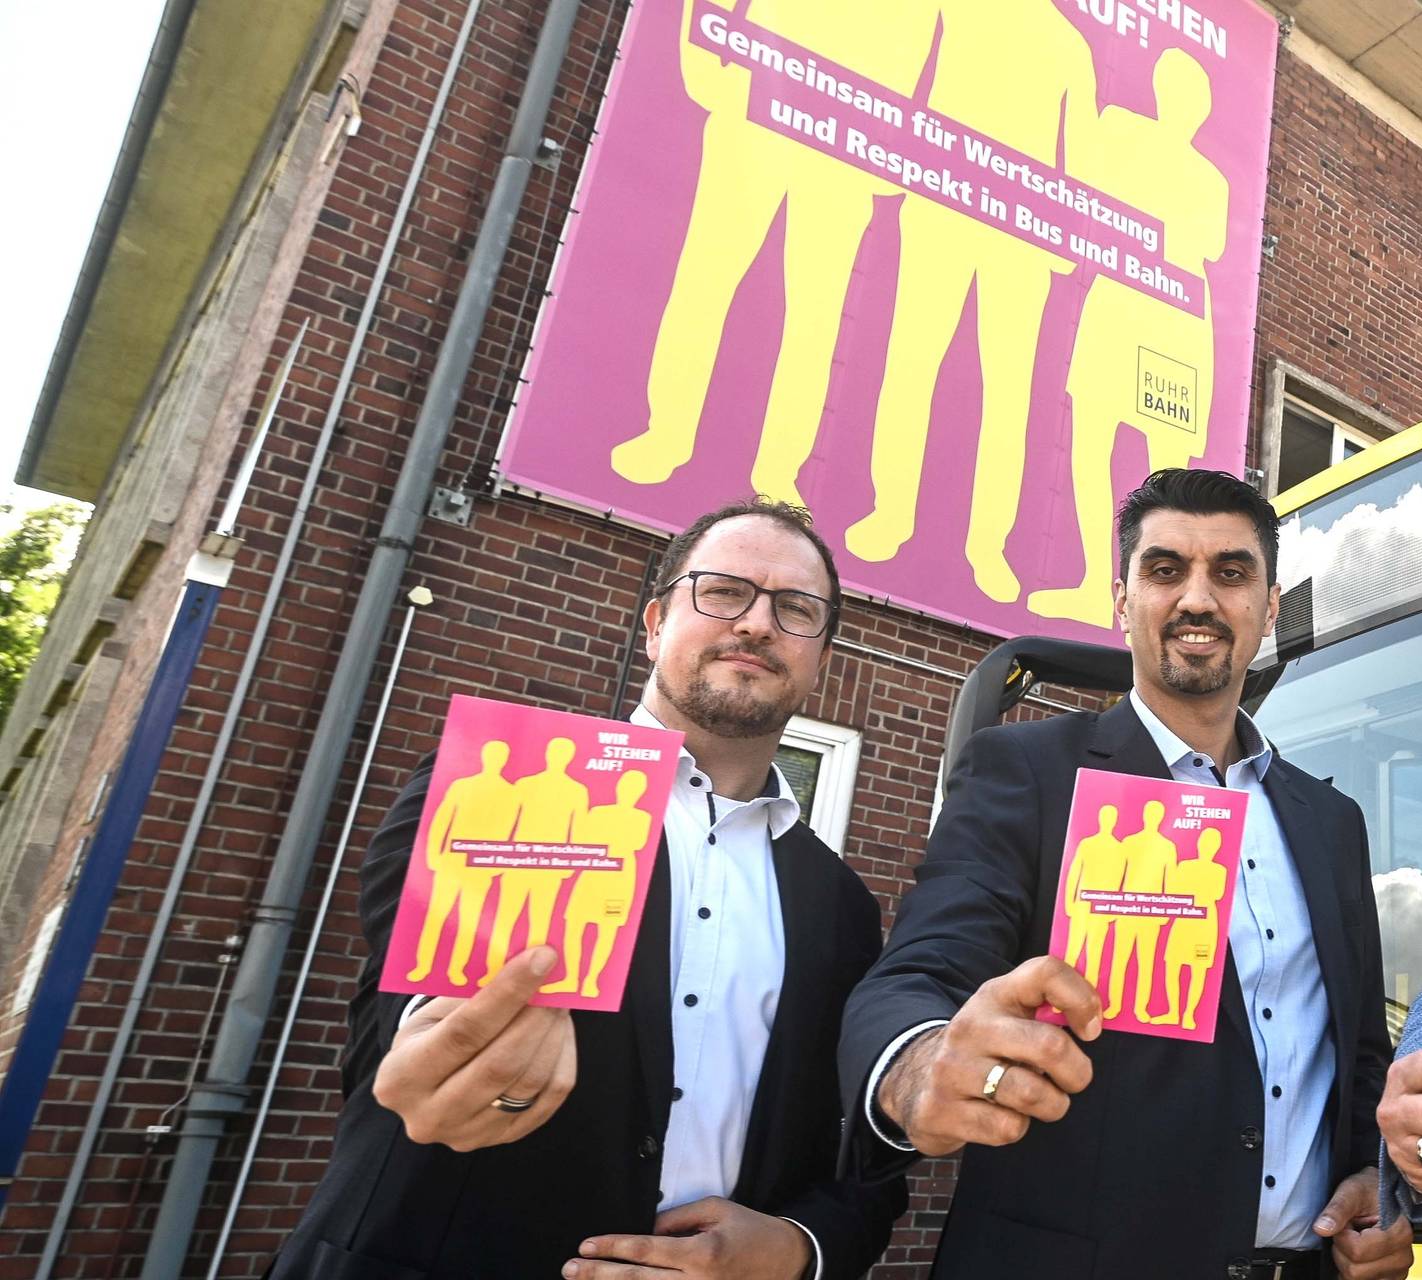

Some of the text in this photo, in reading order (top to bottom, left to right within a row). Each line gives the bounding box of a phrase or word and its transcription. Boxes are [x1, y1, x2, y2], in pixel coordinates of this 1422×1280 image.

[699, 13, 1158, 252] Gemeinsam für Wertschätzung
[770, 99, 1191, 303] und Respekt in Bus und Bahn.
[1144, 371, 1189, 403] RUHR
[1144, 392, 1189, 423] BAHN
[597, 731, 629, 745] WIR
[603, 746, 661, 761] STEHEN
[585, 758, 624, 772] AUF!
[1181, 794, 1205, 806] WIR
[1185, 806, 1231, 820] STEHEN
[1173, 818, 1202, 830] AUF!
